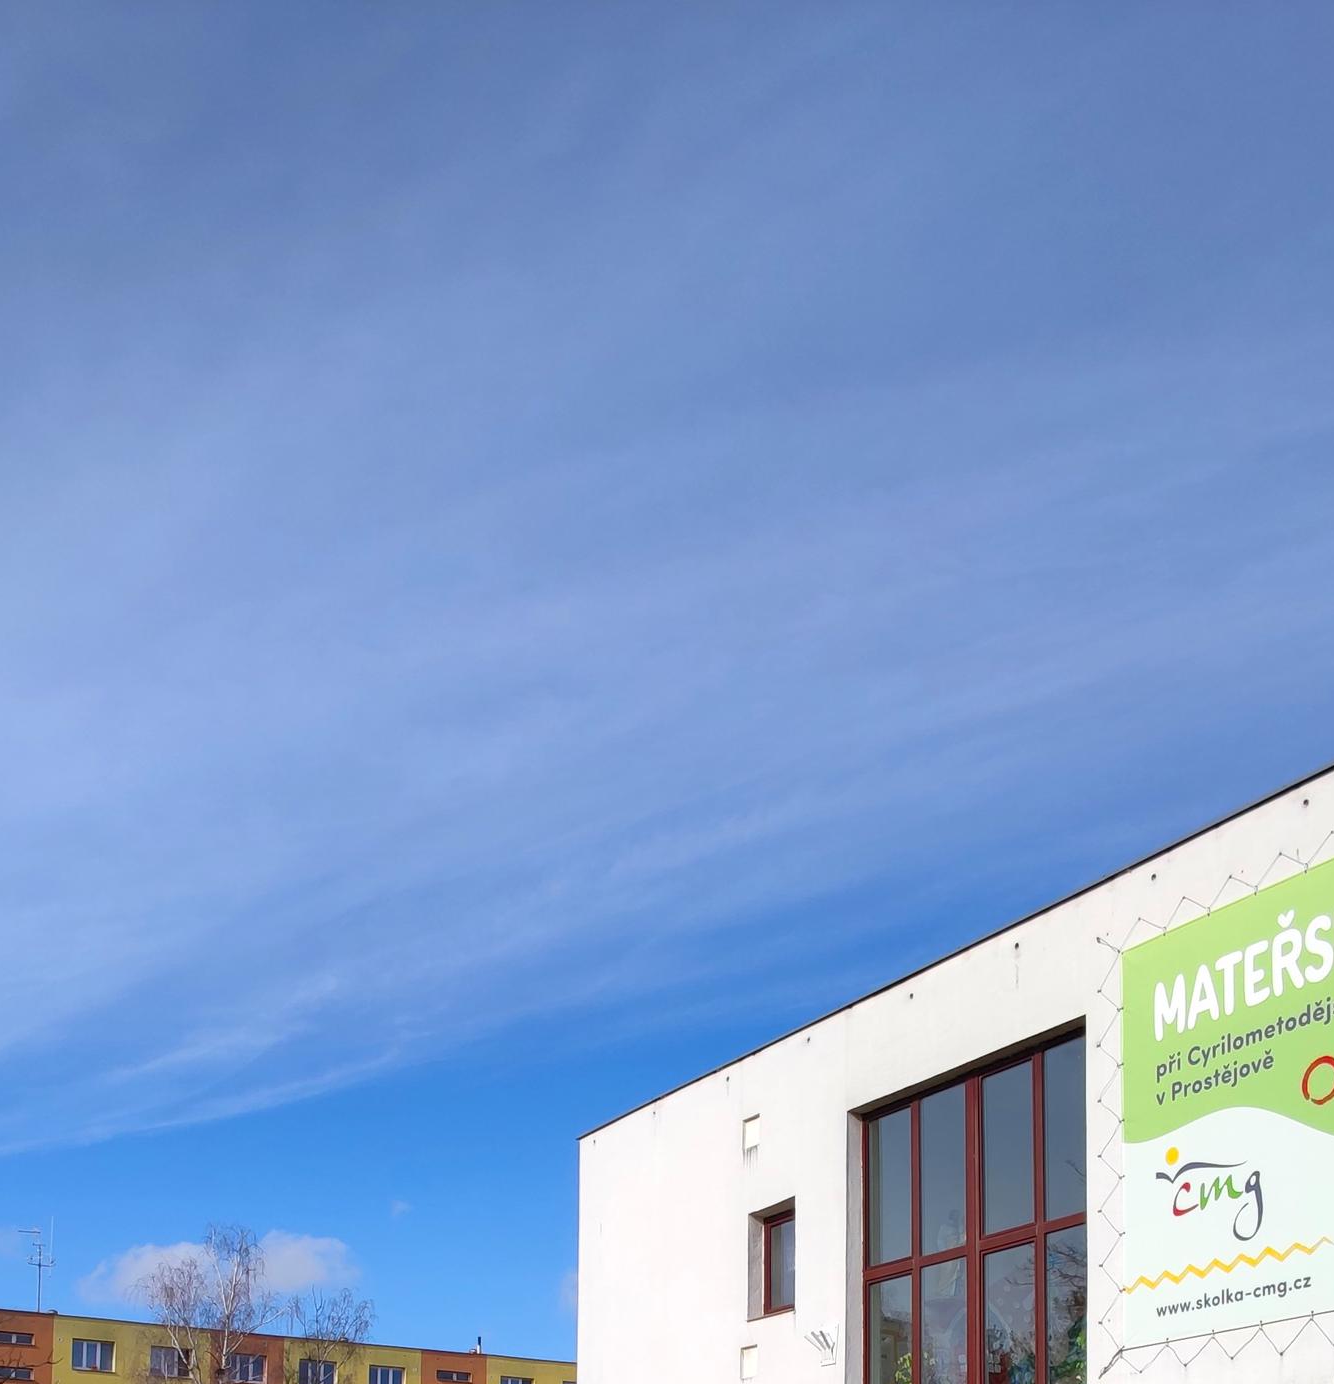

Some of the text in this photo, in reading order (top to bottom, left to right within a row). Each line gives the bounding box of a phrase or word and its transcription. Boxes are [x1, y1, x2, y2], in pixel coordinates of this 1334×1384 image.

[1156, 1051, 1182, 1083] při
[1156, 1049, 1275, 1106] v Prostějově
[1156, 1275, 1312, 1318] www.skolka-cmg.cz
